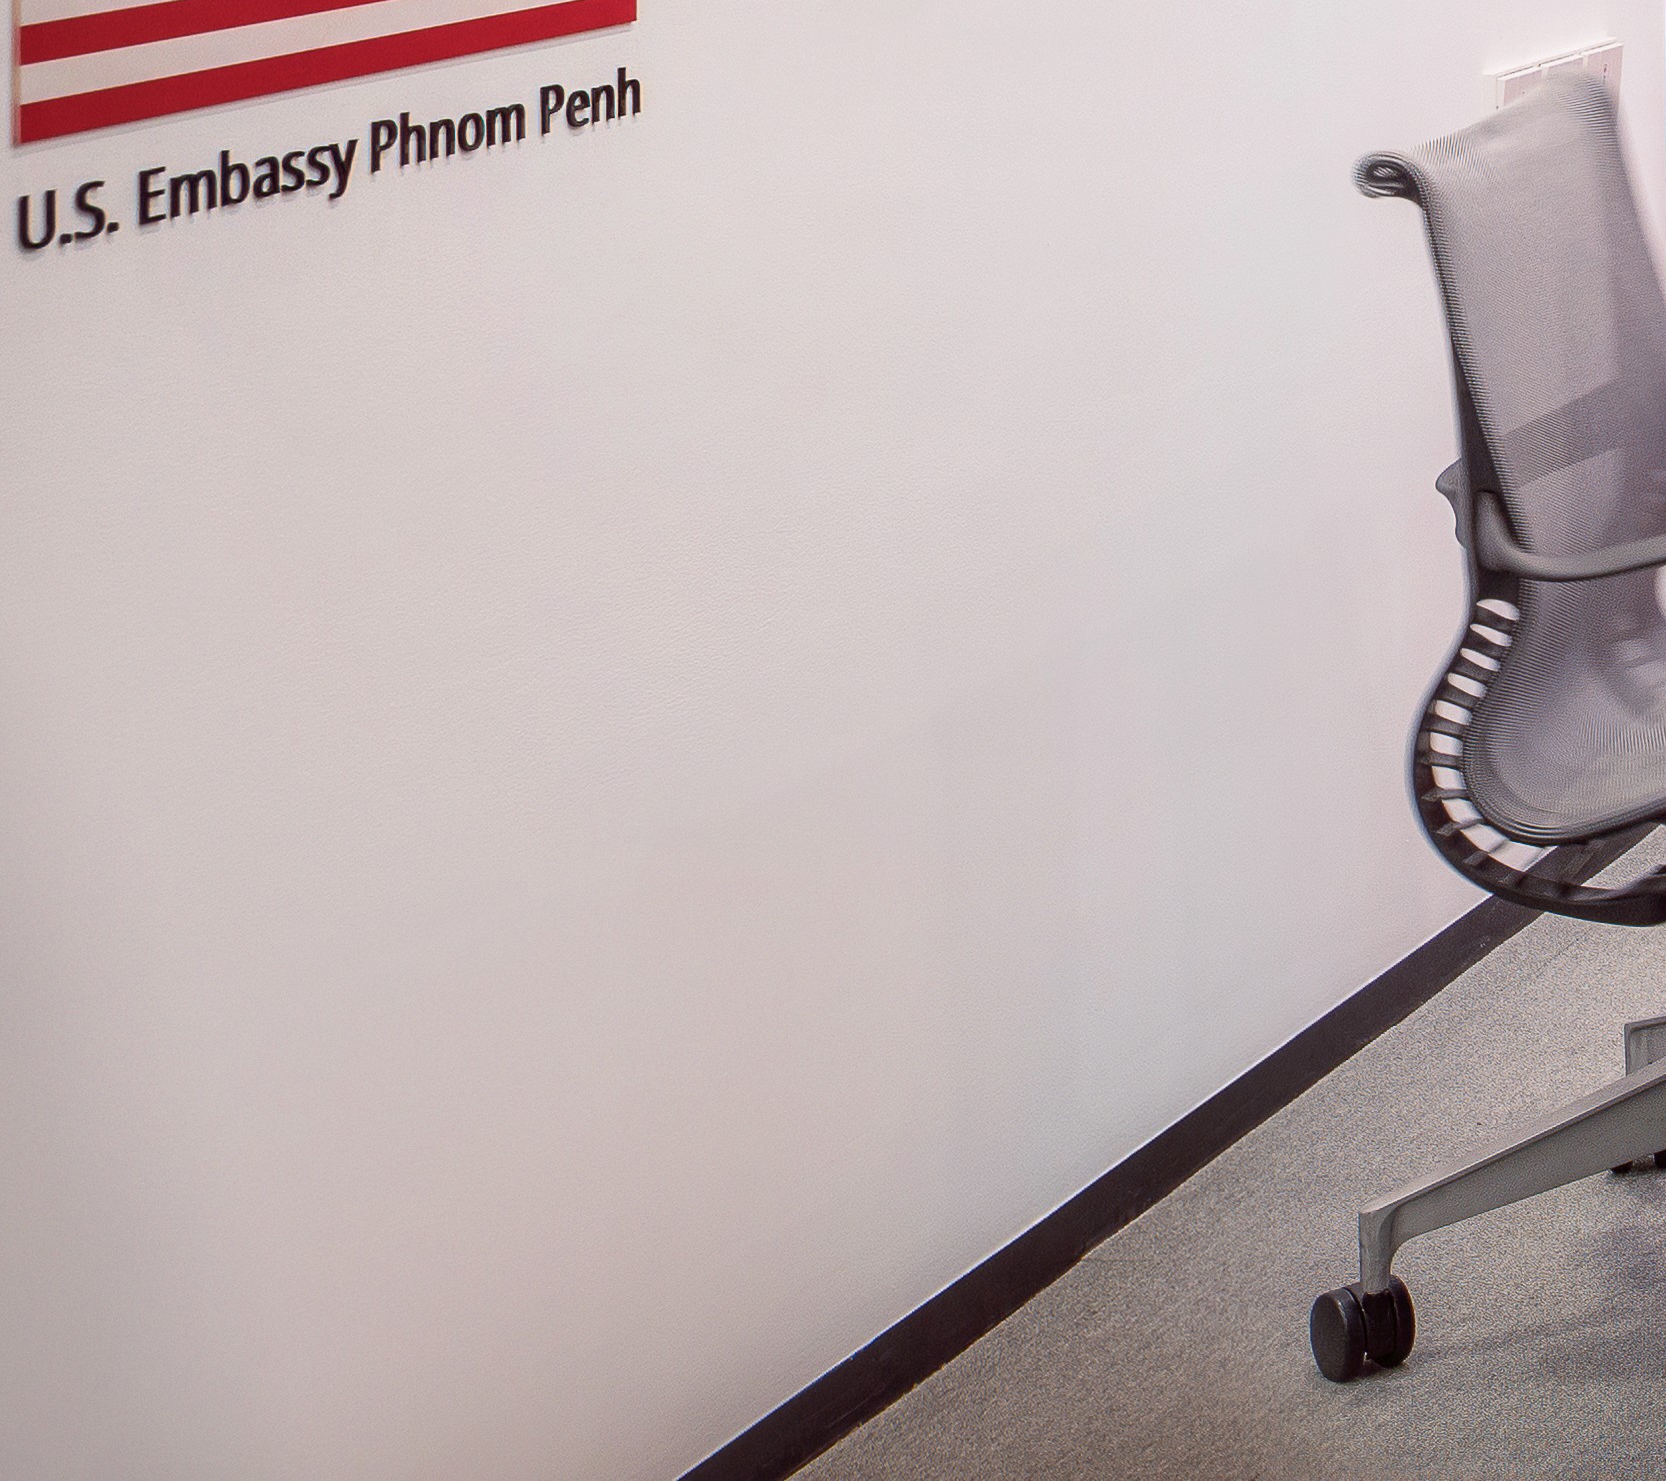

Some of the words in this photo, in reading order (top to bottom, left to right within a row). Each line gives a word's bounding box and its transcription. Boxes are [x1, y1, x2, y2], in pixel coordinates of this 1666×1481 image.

[17, 180, 120, 253] U.S.
[138, 138, 359, 227] Embassy
[370, 103, 526, 175] Phnom
[539, 66, 641, 137] Penh
